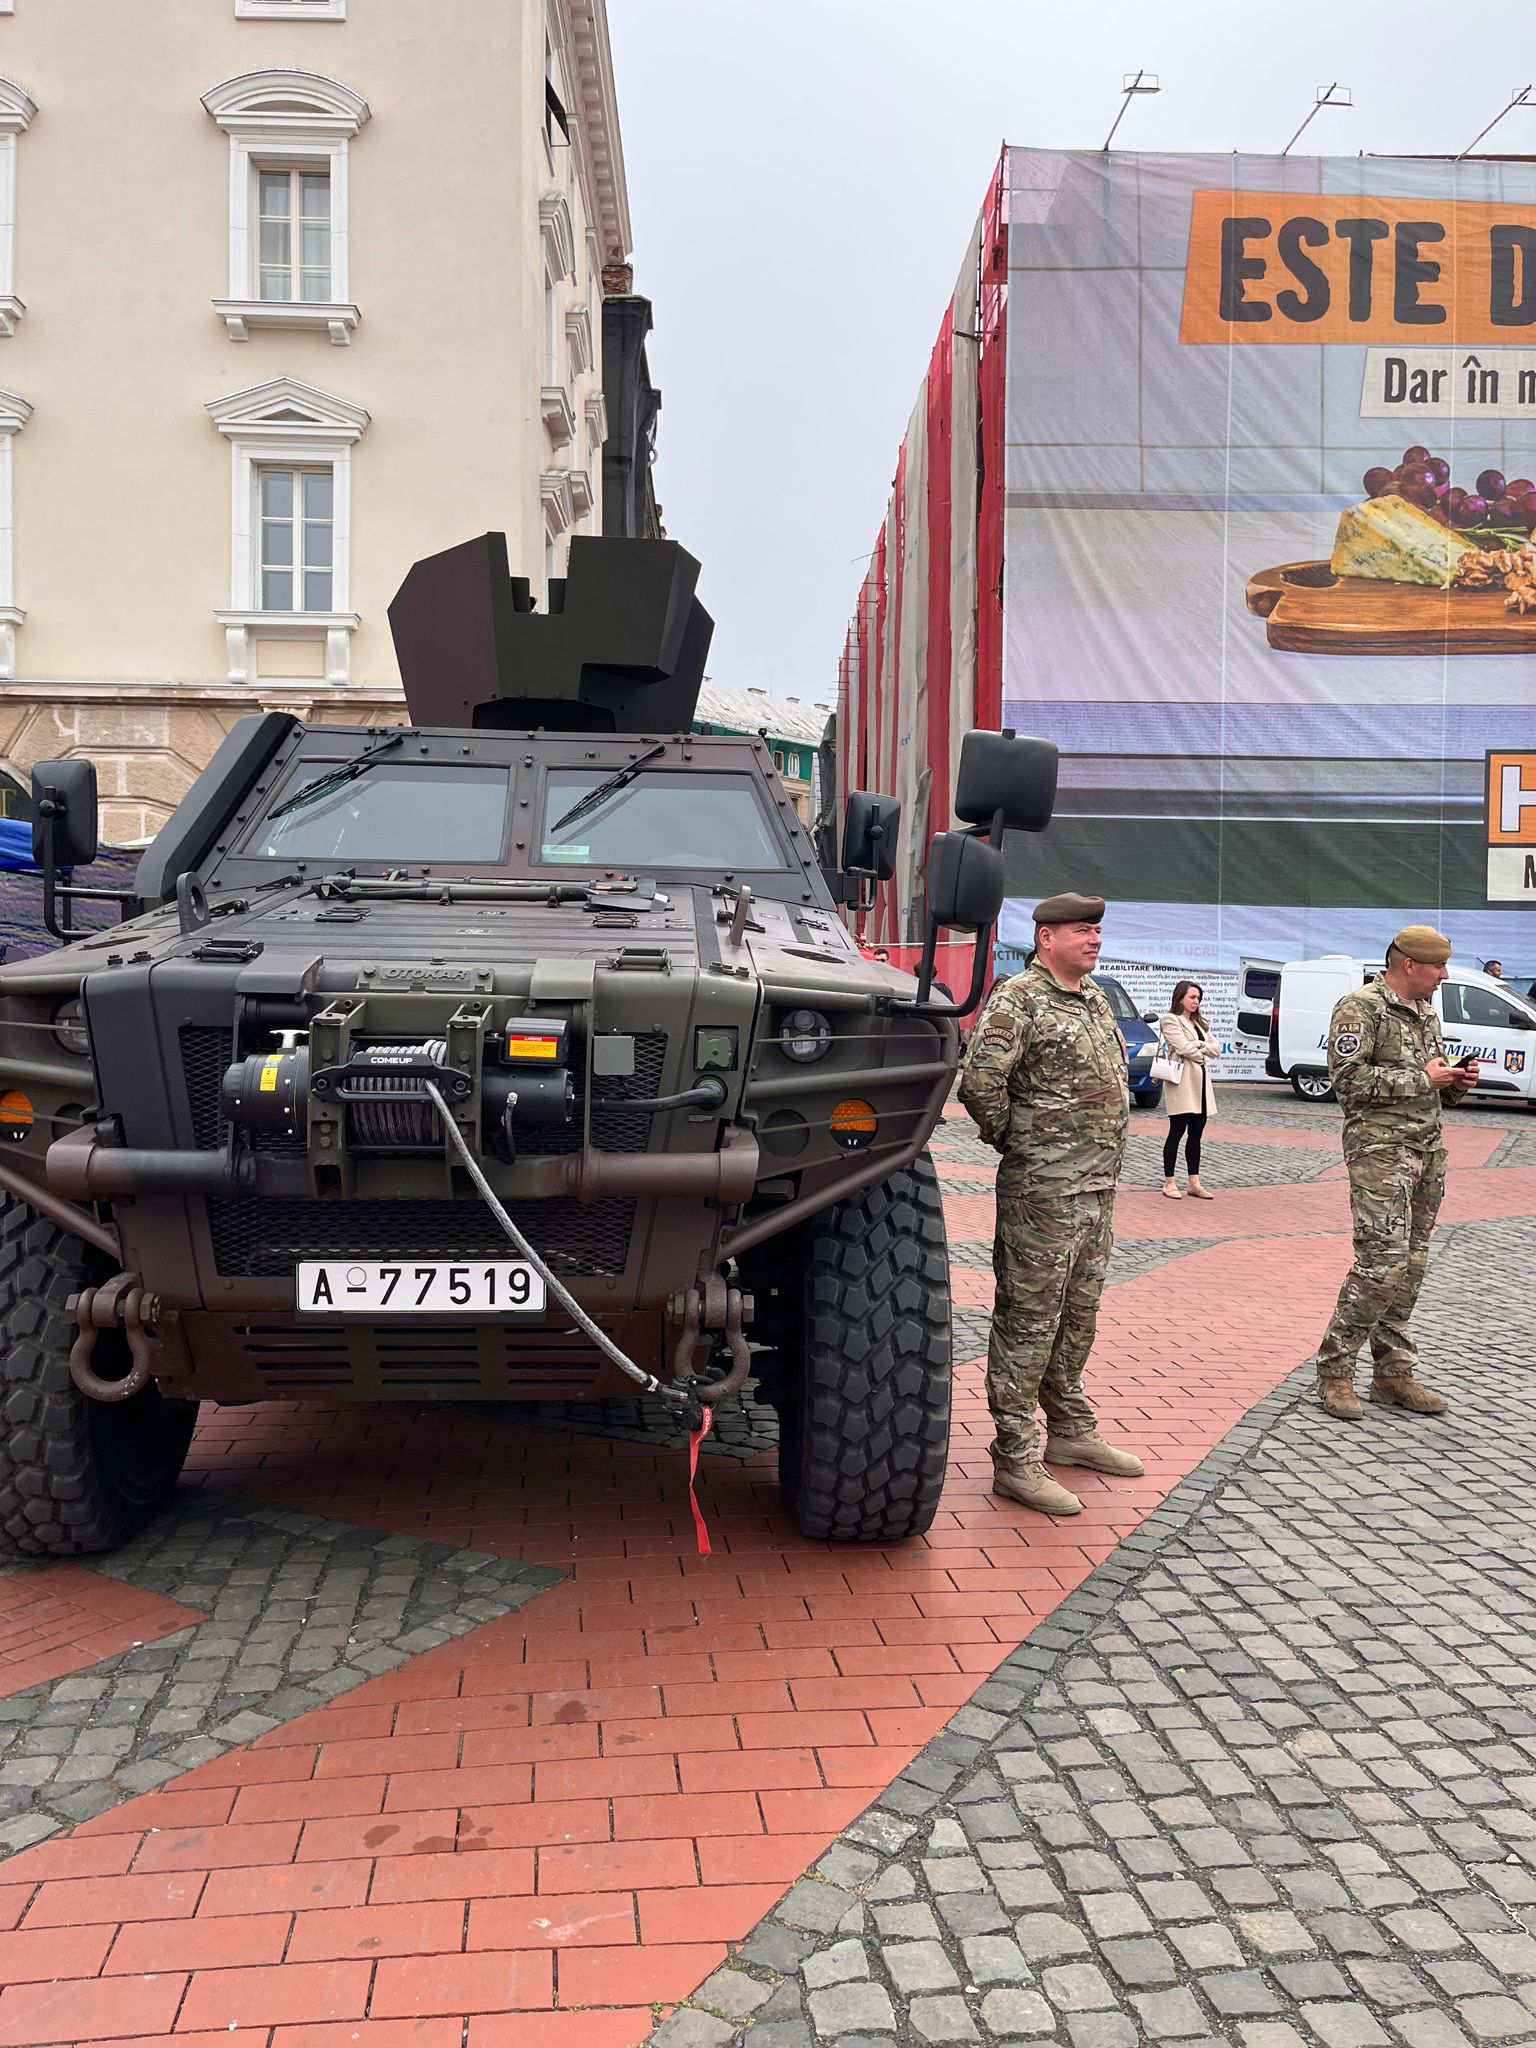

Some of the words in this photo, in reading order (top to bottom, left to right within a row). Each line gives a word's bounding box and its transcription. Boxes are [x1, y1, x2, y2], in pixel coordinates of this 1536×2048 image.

[1220, 217, 1447, 325] ESTE
[1384, 358, 1448, 402] Dar
[1462, 355, 1499, 403] în
[385, 967, 468, 980] OTOKAR
[1099, 964, 1150, 972] REABILITARE
[370, 1056, 413, 1064] COMEUP
